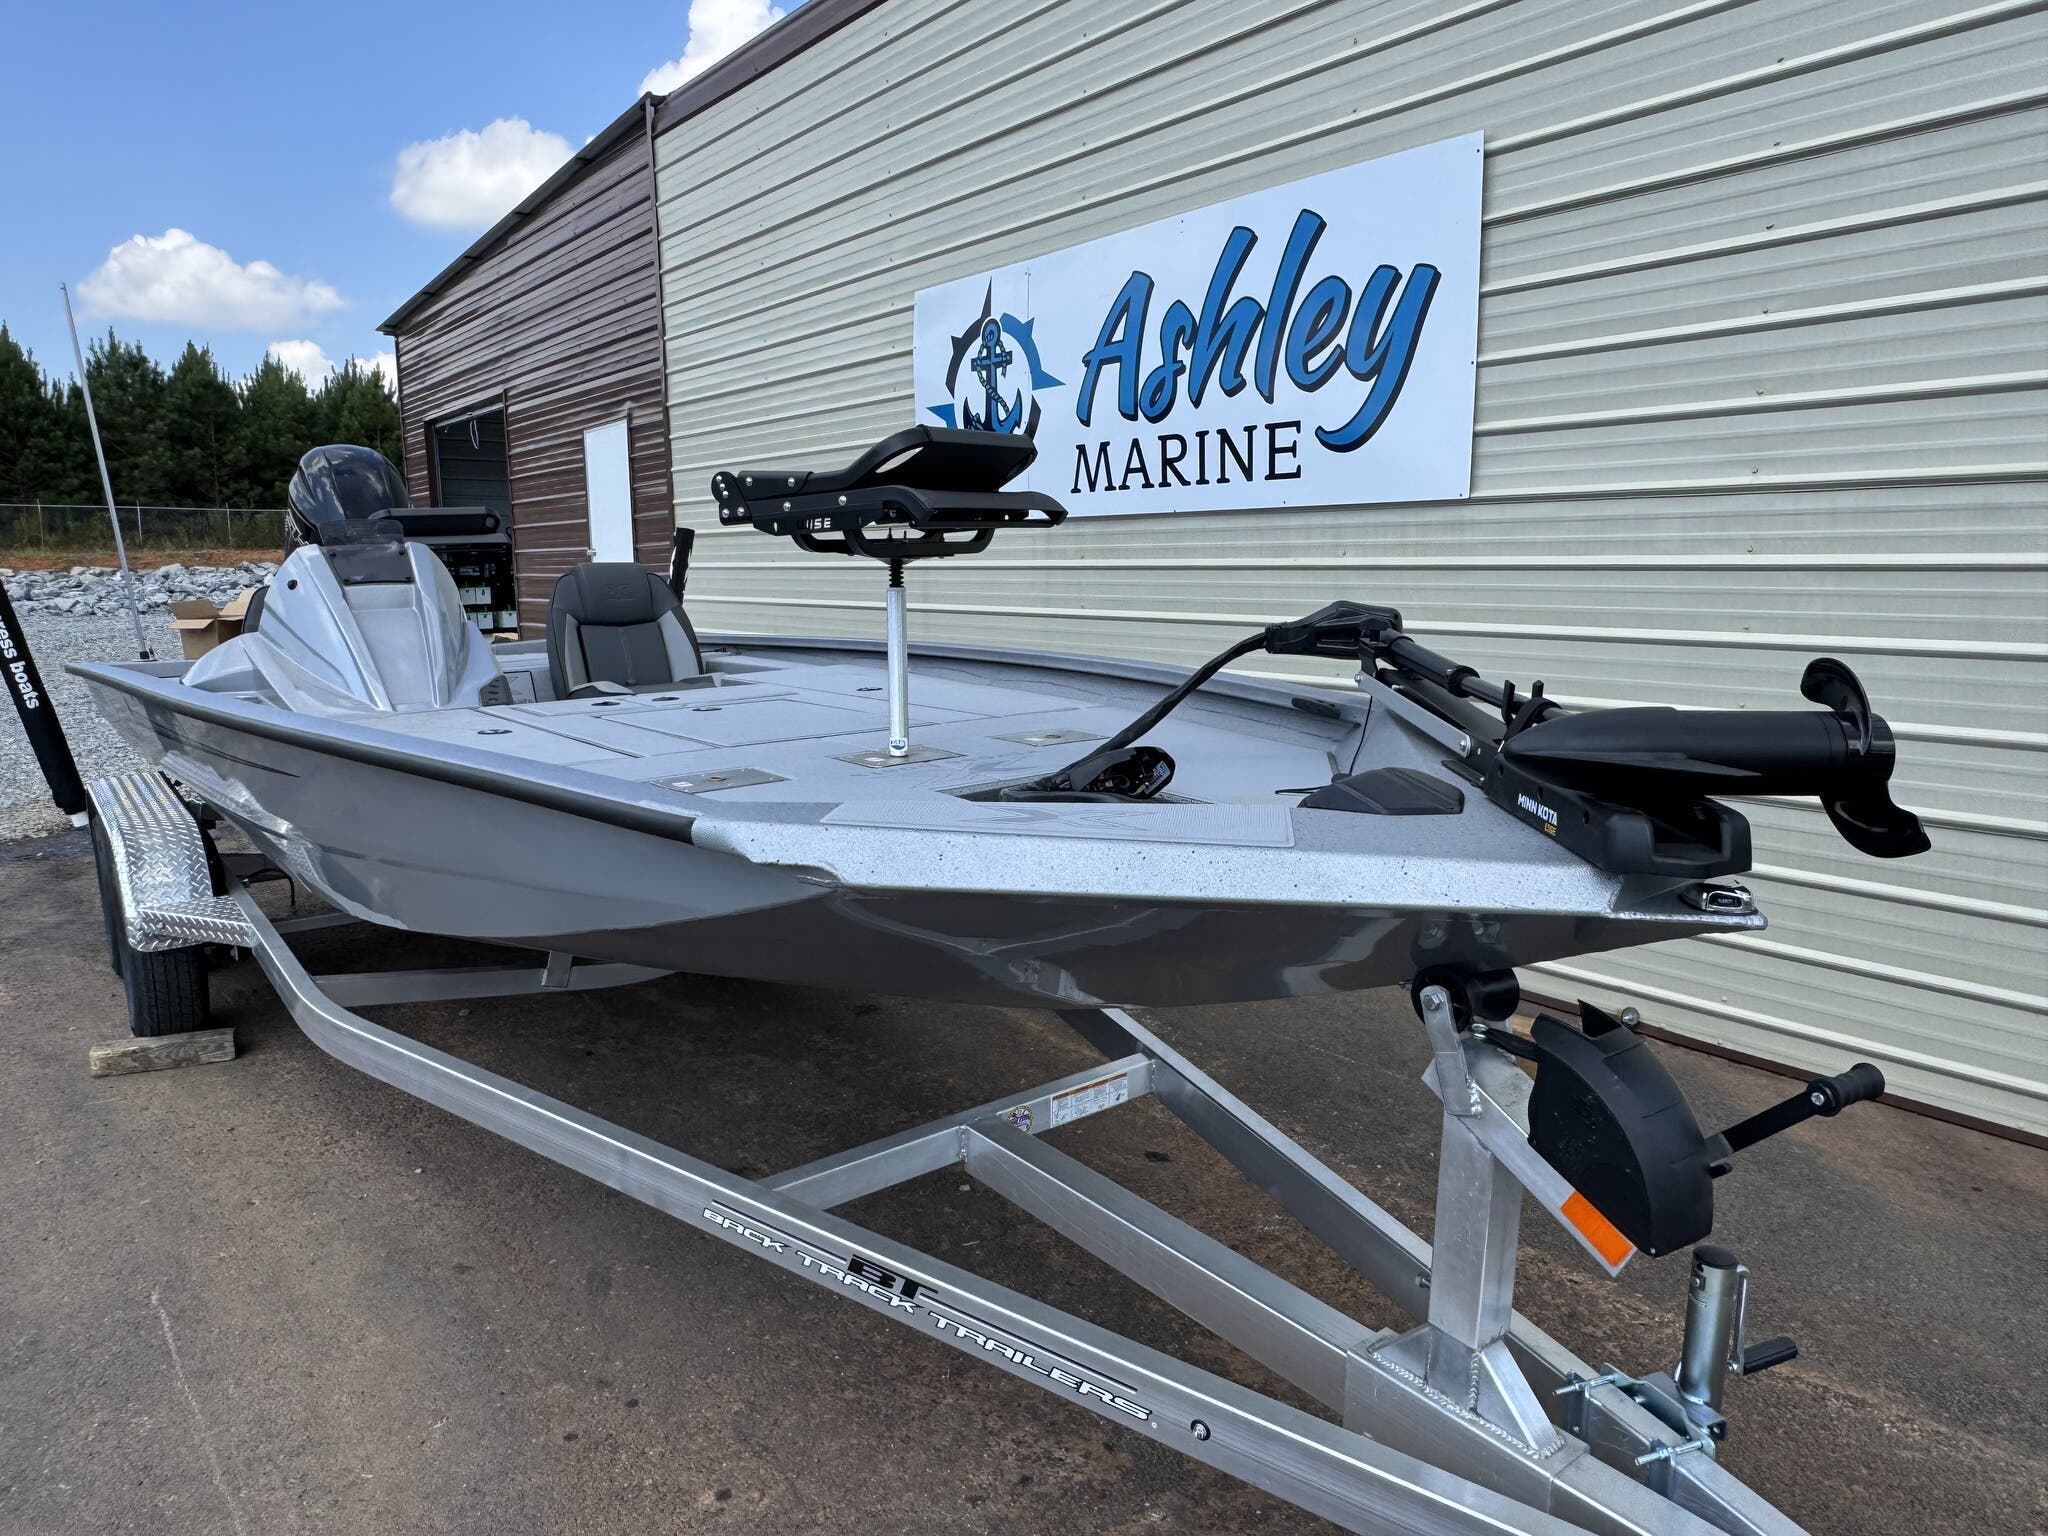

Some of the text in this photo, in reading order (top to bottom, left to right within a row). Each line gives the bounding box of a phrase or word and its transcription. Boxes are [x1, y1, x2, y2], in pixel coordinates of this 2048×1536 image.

[1076, 209, 1442, 453] Ashley
[1070, 420, 1302, 494] MARINE
[9, 660, 40, 709] boats
[1517, 793, 1558, 826] MINN KOTA
[702, 1207, 1153, 1421] BACK TRACK TRAILERS
